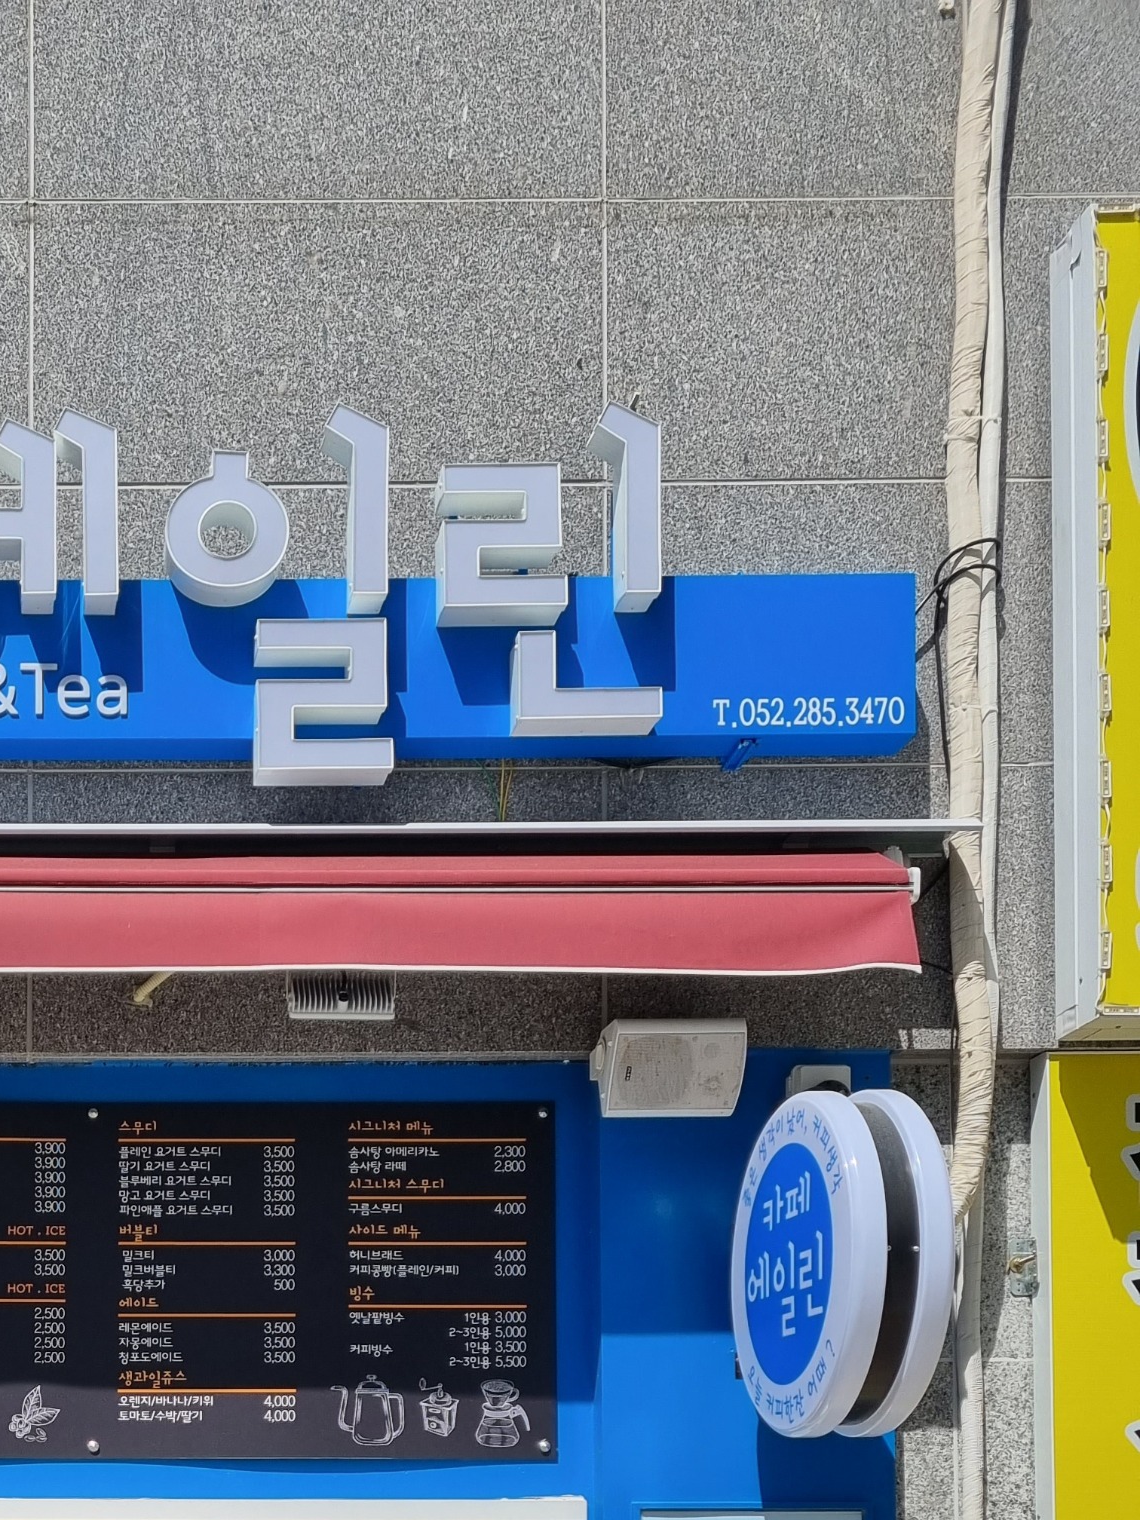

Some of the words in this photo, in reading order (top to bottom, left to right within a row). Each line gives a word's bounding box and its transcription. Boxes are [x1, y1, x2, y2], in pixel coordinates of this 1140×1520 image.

[712, 695, 907, 729] T.052.285.3470
[119, 1121, 156, 1135] 스무디
[349, 1121, 400, 1130] 시그니처
[406, 1121, 433, 1135] 메뉴
[35, 1142, 65, 1154] 3,900
[119, 1147, 151, 1159] 플레인
[154, 1147, 186, 1156] 요거트
[189, 1147, 220, 1156] 스무디
[264, 1146, 294, 1158] 3,500
[349, 1147, 382, 1159] 솜사탕
[385, 1147, 439, 1156] 아메리카노
[494, 1146, 525, 1157] 2,300
[35, 1157, 65, 1168] 3,900
[119, 1161, 139, 1173] 딸기
[144, 1161, 176, 1171] 요거트
[179, 1161, 210, 1171] 스무디
[264, 1160, 294, 1172] 3,500
[348, 1161, 382, 1174] 솜사탕
[385, 1162, 406, 1171] 라떼
[494, 1160, 526, 1172] 2,800
[35, 1172, 65, 1183] 3,900
[119, 1176, 161, 1188] 블루베리
[165, 1176, 197, 1185] 요거트
[200, 1176, 231, 1185] 스무디
[264, 1175, 295, 1187] 3,500
[35, 1186, 65, 1198] 3,900
[349, 1179, 400, 1188] 시그니처
[406, 1179, 444, 1193] 스무디
[119, 1191, 141, 1203] 망고
[144, 1191, 176, 1200] 요거트
[179, 1191, 210, 1200] 스무디
[264, 1190, 295, 1201] 3,500
[760, 1169, 812, 1233] 카페
[35, 1201, 65, 1212] 3,900
[119, 1205, 163, 1217] 파인애플
[166, 1205, 198, 1214] 요거트
[201, 1205, 232, 1215] 스무디
[264, 1205, 295, 1216] 3,500
[349, 1203, 402, 1216] 구름스무디
[494, 1203, 526, 1214] 4,000
[120, 1224, 157, 1242] 버블티
[349, 1224, 388, 1234] 사이드
[394, 1225, 420, 1239] 메뉴
[123, 1250, 154, 1262] 밀크티
[264, 1250, 295, 1261] 3,000
[350, 1250, 403, 1260] 허니브래드
[494, 1250, 526, 1261] 4,000
[123, 1265, 175, 1277] 밀크버블티
[264, 1264, 295, 1276] 3,300
[746, 1229, 824, 1338] 에일린
[350, 1286, 374, 1301] 빙수
[119, 1297, 158, 1307] 에이드
[35, 1307, 65, 1319] 2,500
[349, 1312, 404, 1324] 옛날팥빙수
[465, 1313, 490, 1325] 1인용
[495, 1311, 526, 1323] 3,000
[119, 1323, 173, 1335] 레몬에이드
[264, 1322, 295, 1334] 3,500
[119, 1337, 173, 1350] 자몽에이드
[264, 1337, 295, 1348] 3,500
[350, 1345, 393, 1357] 커피빙수
[465, 1342, 491, 1354] 1인용
[495, 1341, 526, 1352] 3,500
[34, 1352, 65, 1363] 2,500
[119, 1352, 183, 1364] 청포도에이드
[264, 1351, 295, 1363] 3,500
[119, 1371, 186, 1388] 생과일쥬스
[118, 1396, 213, 1408] 오렌지/바나나/키위
[264, 1395, 295, 1407] 4,000
